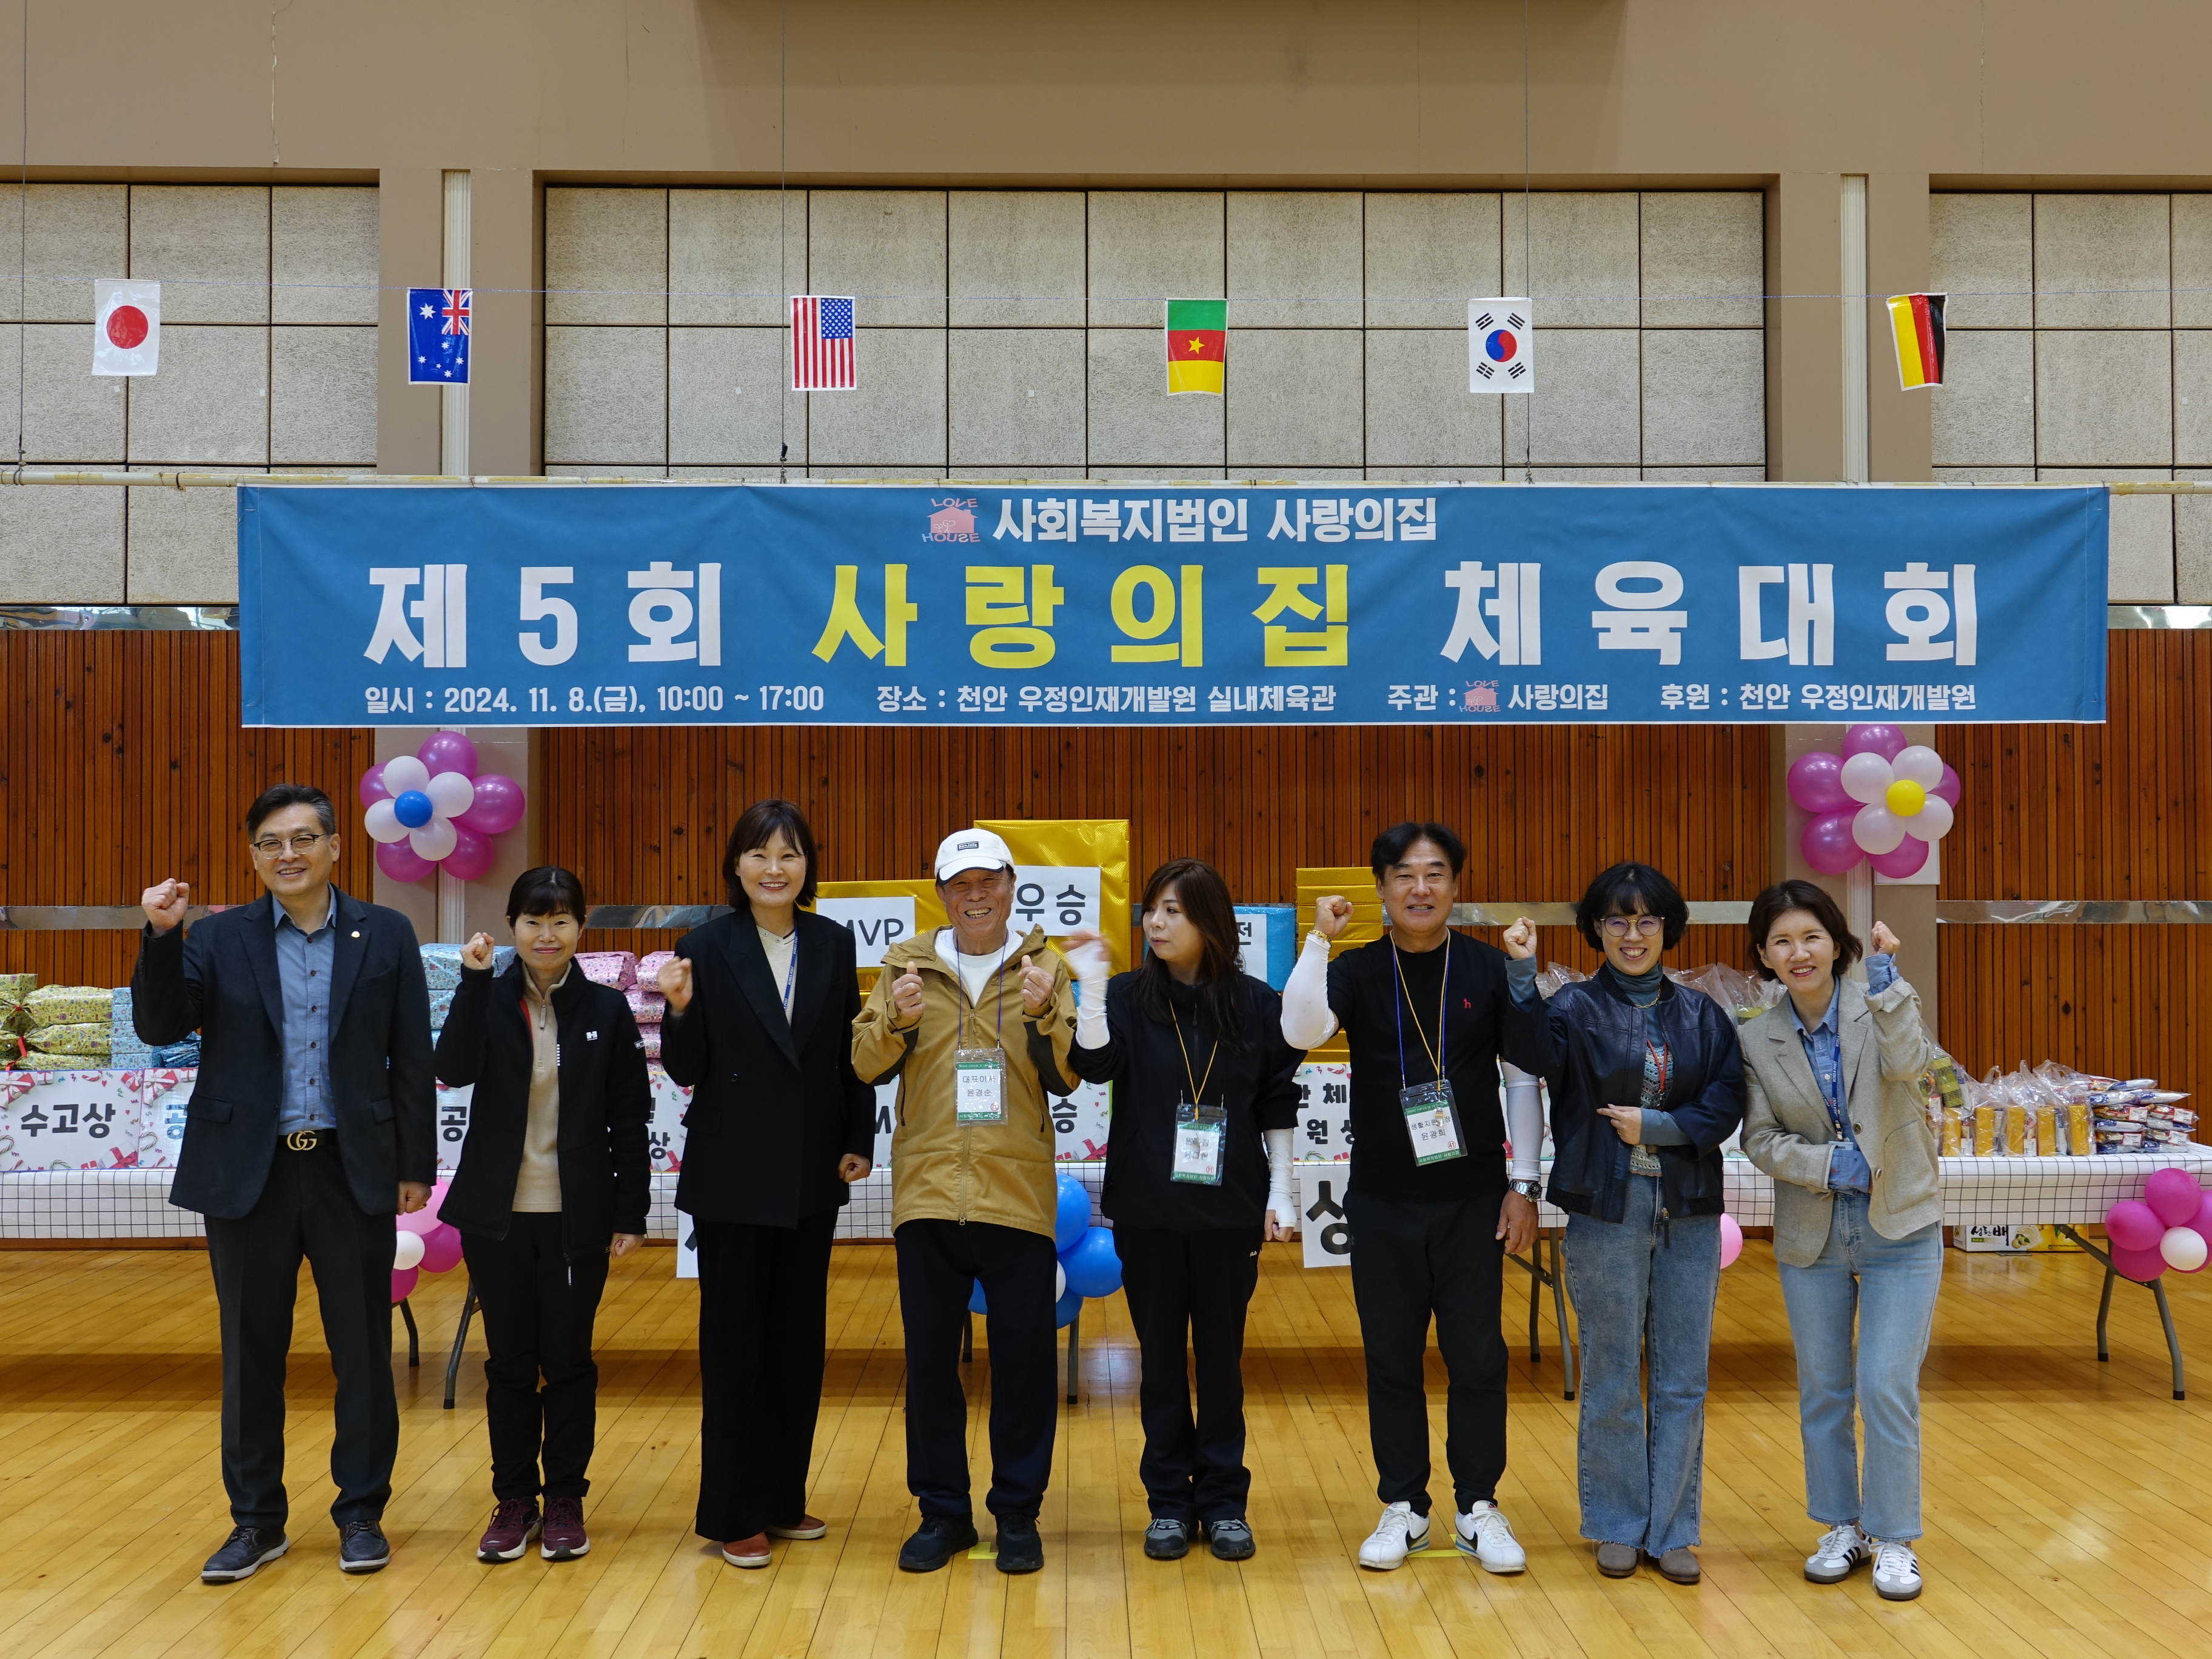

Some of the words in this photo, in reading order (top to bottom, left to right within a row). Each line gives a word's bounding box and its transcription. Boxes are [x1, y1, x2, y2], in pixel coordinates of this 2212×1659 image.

[931, 498, 978, 508] LOVE
[993, 498, 1247, 542] 사회복지법인
[1267, 498, 1436, 542] 사랑의집
[922, 533, 980, 543] HOUSE
[366, 687, 413, 713] 일시
[444, 688, 517, 712] 2024.
[529, 688, 557, 712] 11.
[658, 686, 723, 711] 10:00
[759, 686, 824, 711] 17:00
[877, 686, 927, 712] 장소
[957, 686, 1007, 712] 천안
[1019, 686, 1196, 712] 우정인재개발원
[1208, 685, 1336, 712] 실내체육관
[1389, 685, 1439, 711] 주관
[1507, 685, 1608, 711] 사랑의집
[1661, 684, 1710, 710] 후원
[1740, 684, 1791, 710] 천안
[1801, 684, 1976, 711] 우정인재개발원
[1016, 883, 1086, 925] 우승
[21, 1103, 116, 1139] 수고상
